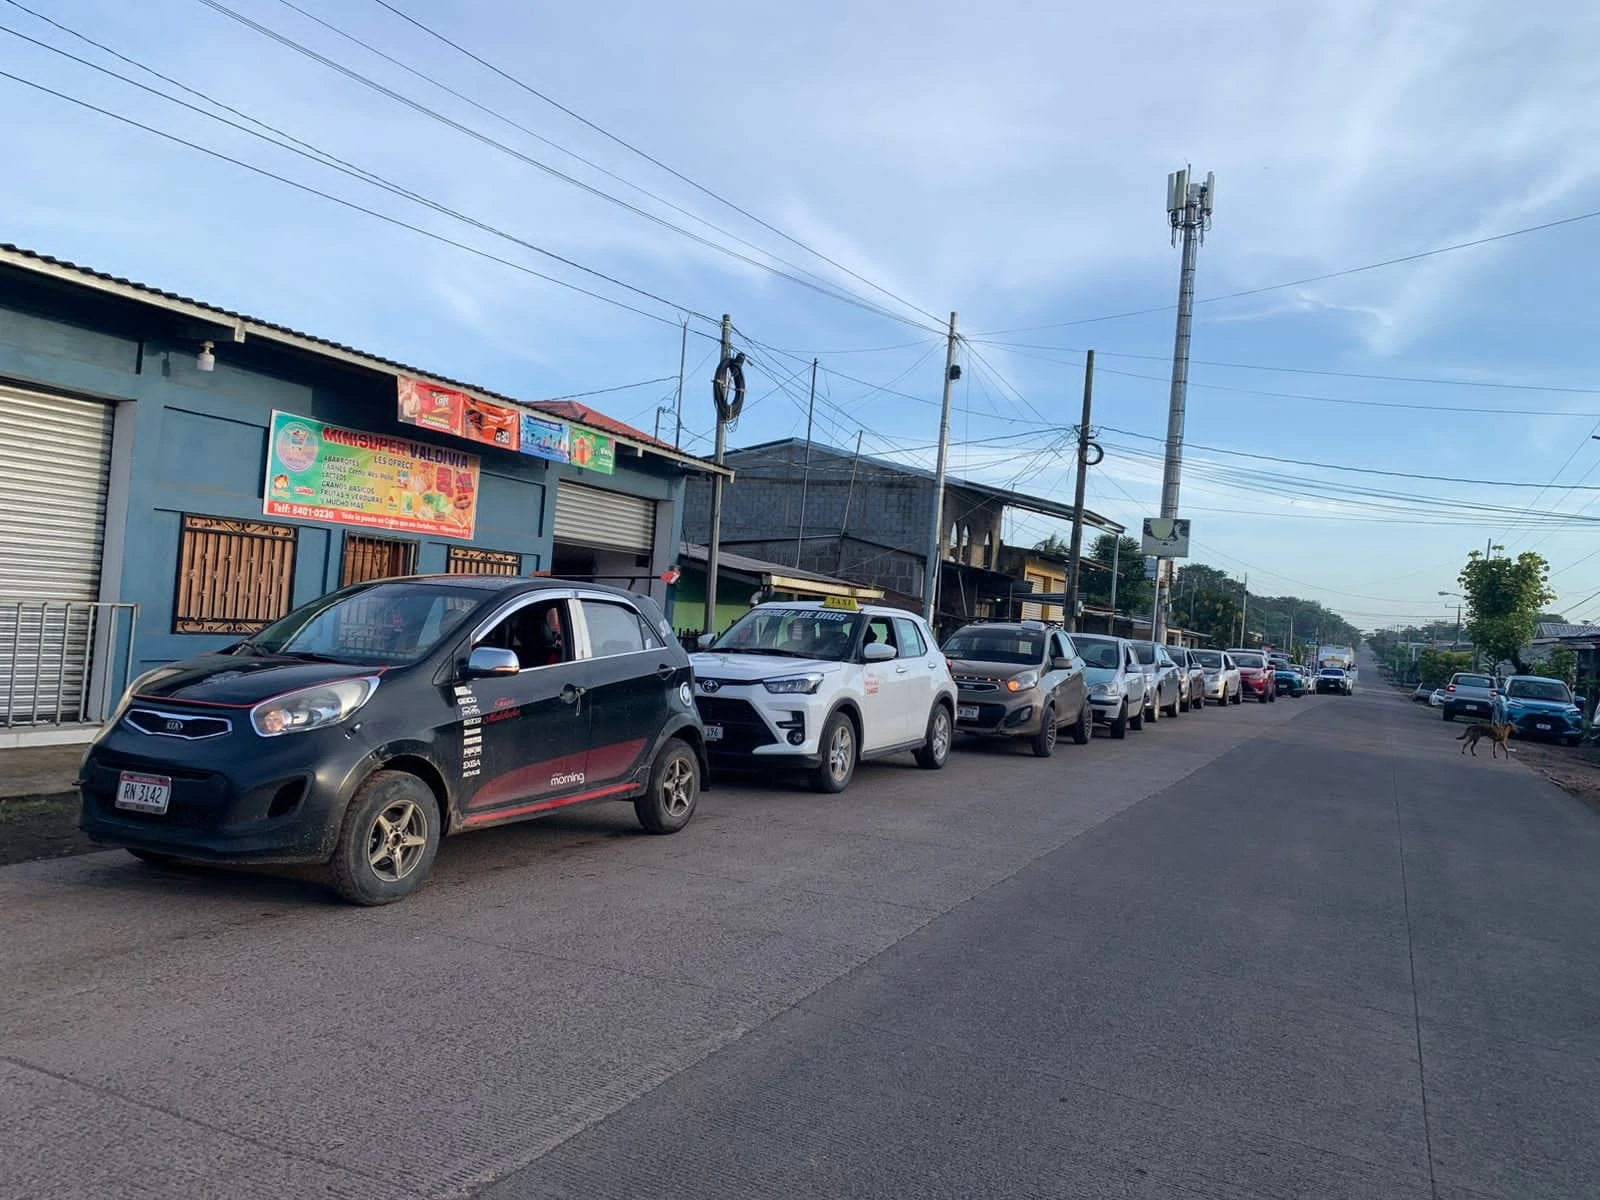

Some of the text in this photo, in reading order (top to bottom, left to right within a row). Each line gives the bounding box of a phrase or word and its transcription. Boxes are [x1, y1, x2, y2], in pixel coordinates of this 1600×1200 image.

[322, 427, 407, 456] MINISUPER
[409, 443, 469, 469] VALDIVIA
[388, 458, 414, 470] OFRECE
[320, 489, 344, 498] FRUTAS
[831, 598, 852, 606] TAXI
[799, 610, 816, 619] DE
[815, 612, 848, 621] DIOS
[550, 772, 584, 785] morning
[124, 783, 163, 804] RN 3142
